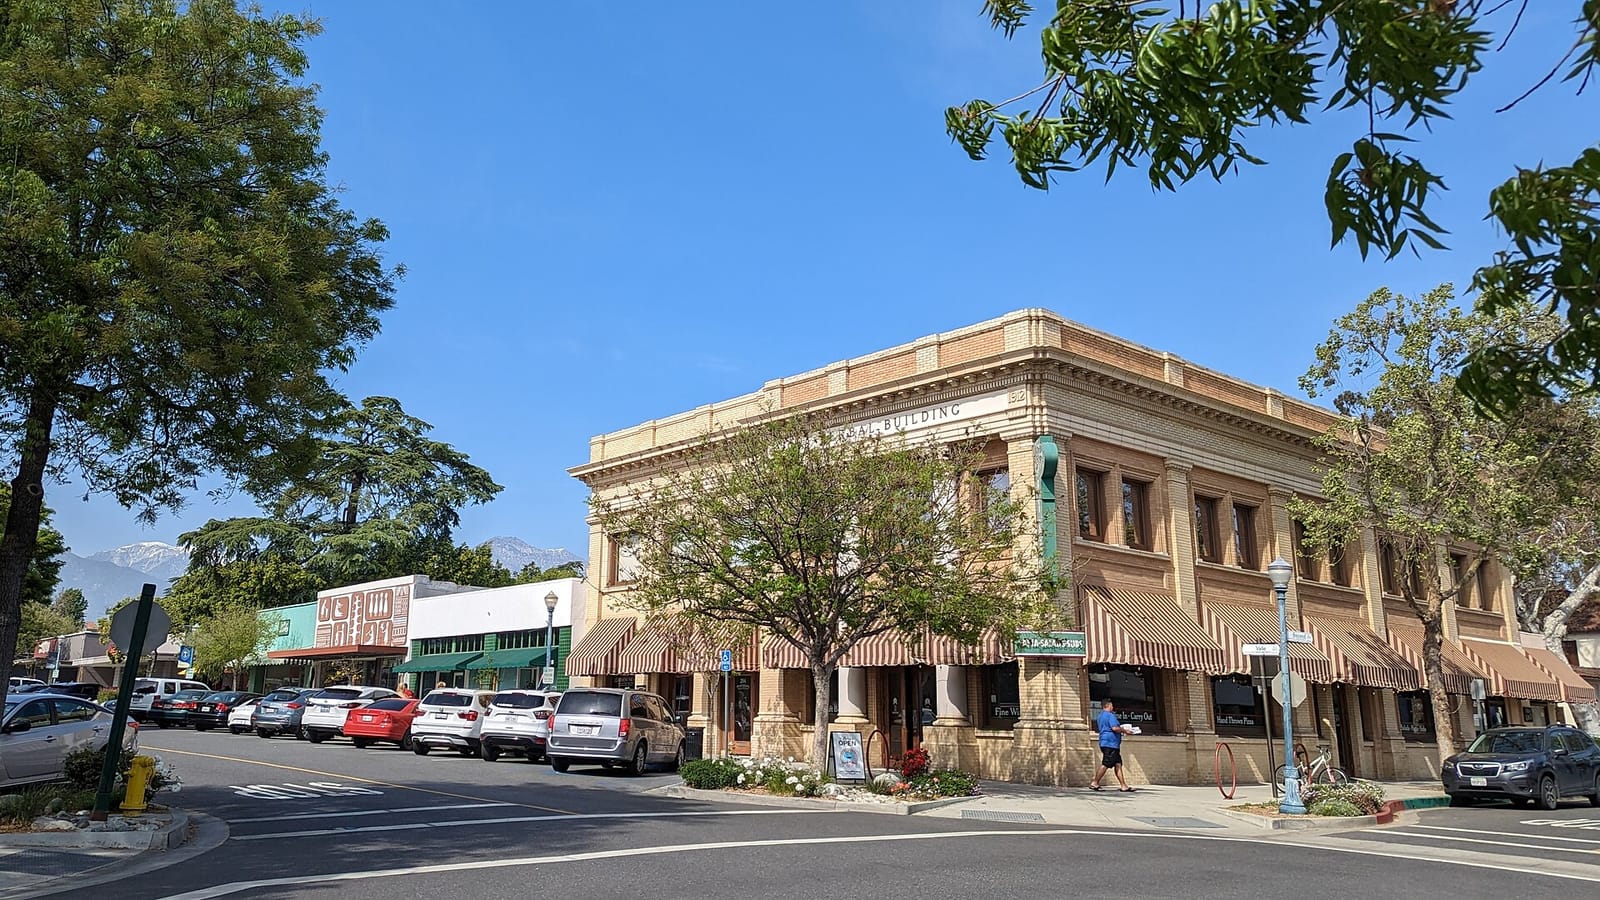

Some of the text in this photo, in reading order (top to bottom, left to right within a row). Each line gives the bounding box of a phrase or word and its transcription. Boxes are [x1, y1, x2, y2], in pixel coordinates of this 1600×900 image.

[1008, 390, 1025, 403] 1912
[884, 403, 961, 431] BUILDING
[995, 707, 1020, 716] Fine Wi
[1130, 711, 1144, 721] Carry
[1144, 712, 1153, 721] Out
